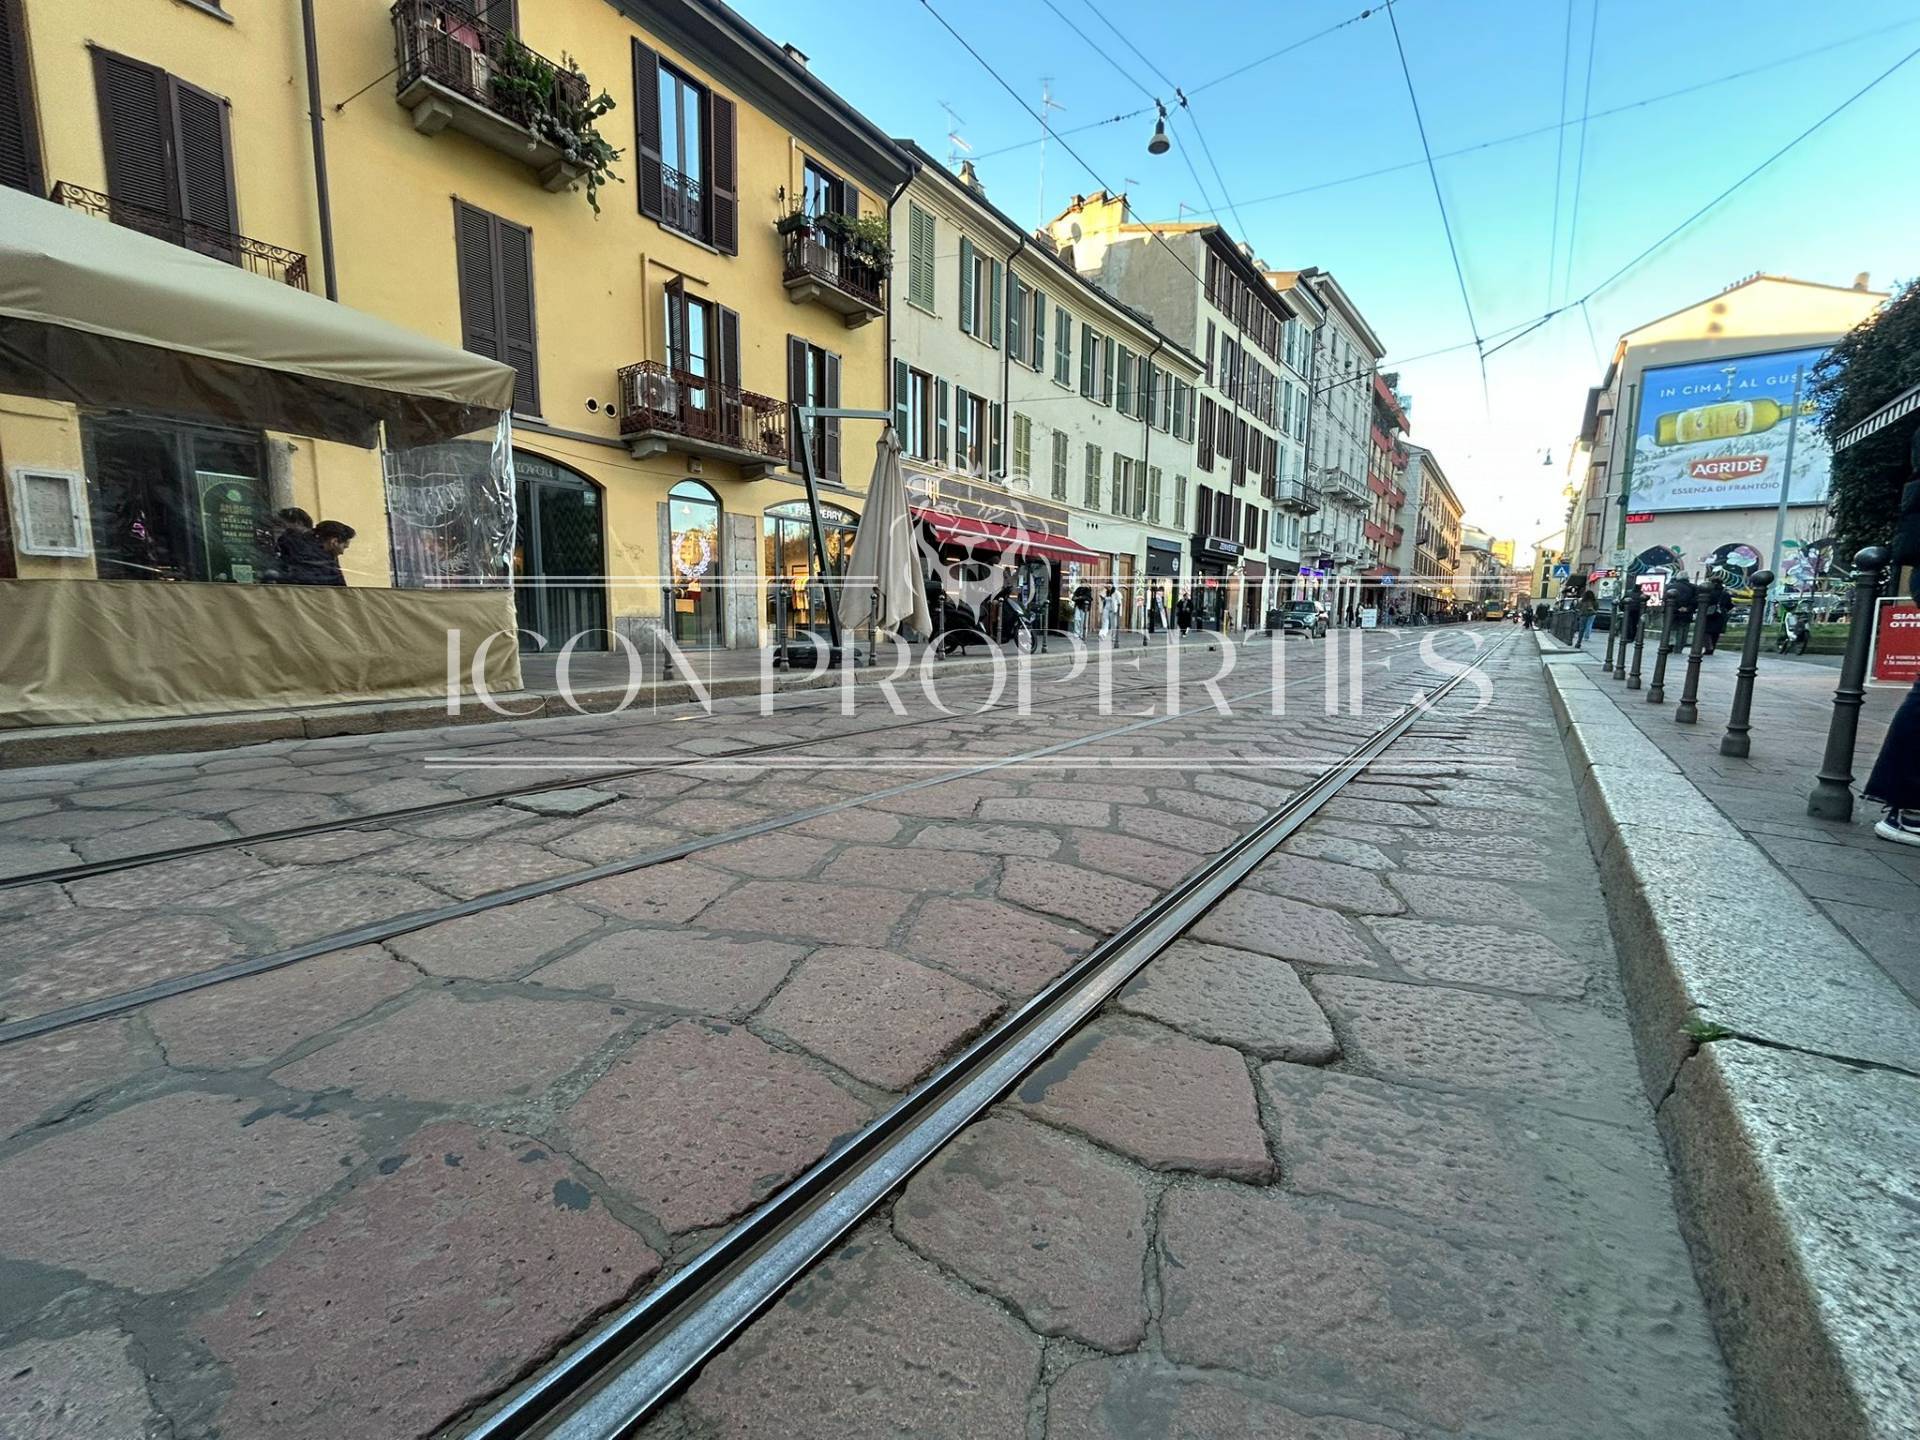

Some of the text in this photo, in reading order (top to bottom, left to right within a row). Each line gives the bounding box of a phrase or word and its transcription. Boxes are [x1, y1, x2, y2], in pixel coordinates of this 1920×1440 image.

[1660, 388, 1676, 398] IN
[1682, 385, 1722, 395] CIMA
[1739, 378, 1759, 388] AL
[1692, 458, 1762, 476] AGRIDÈ
[1671, 481, 1780, 495] ESSENZA DI FRANTOIO
